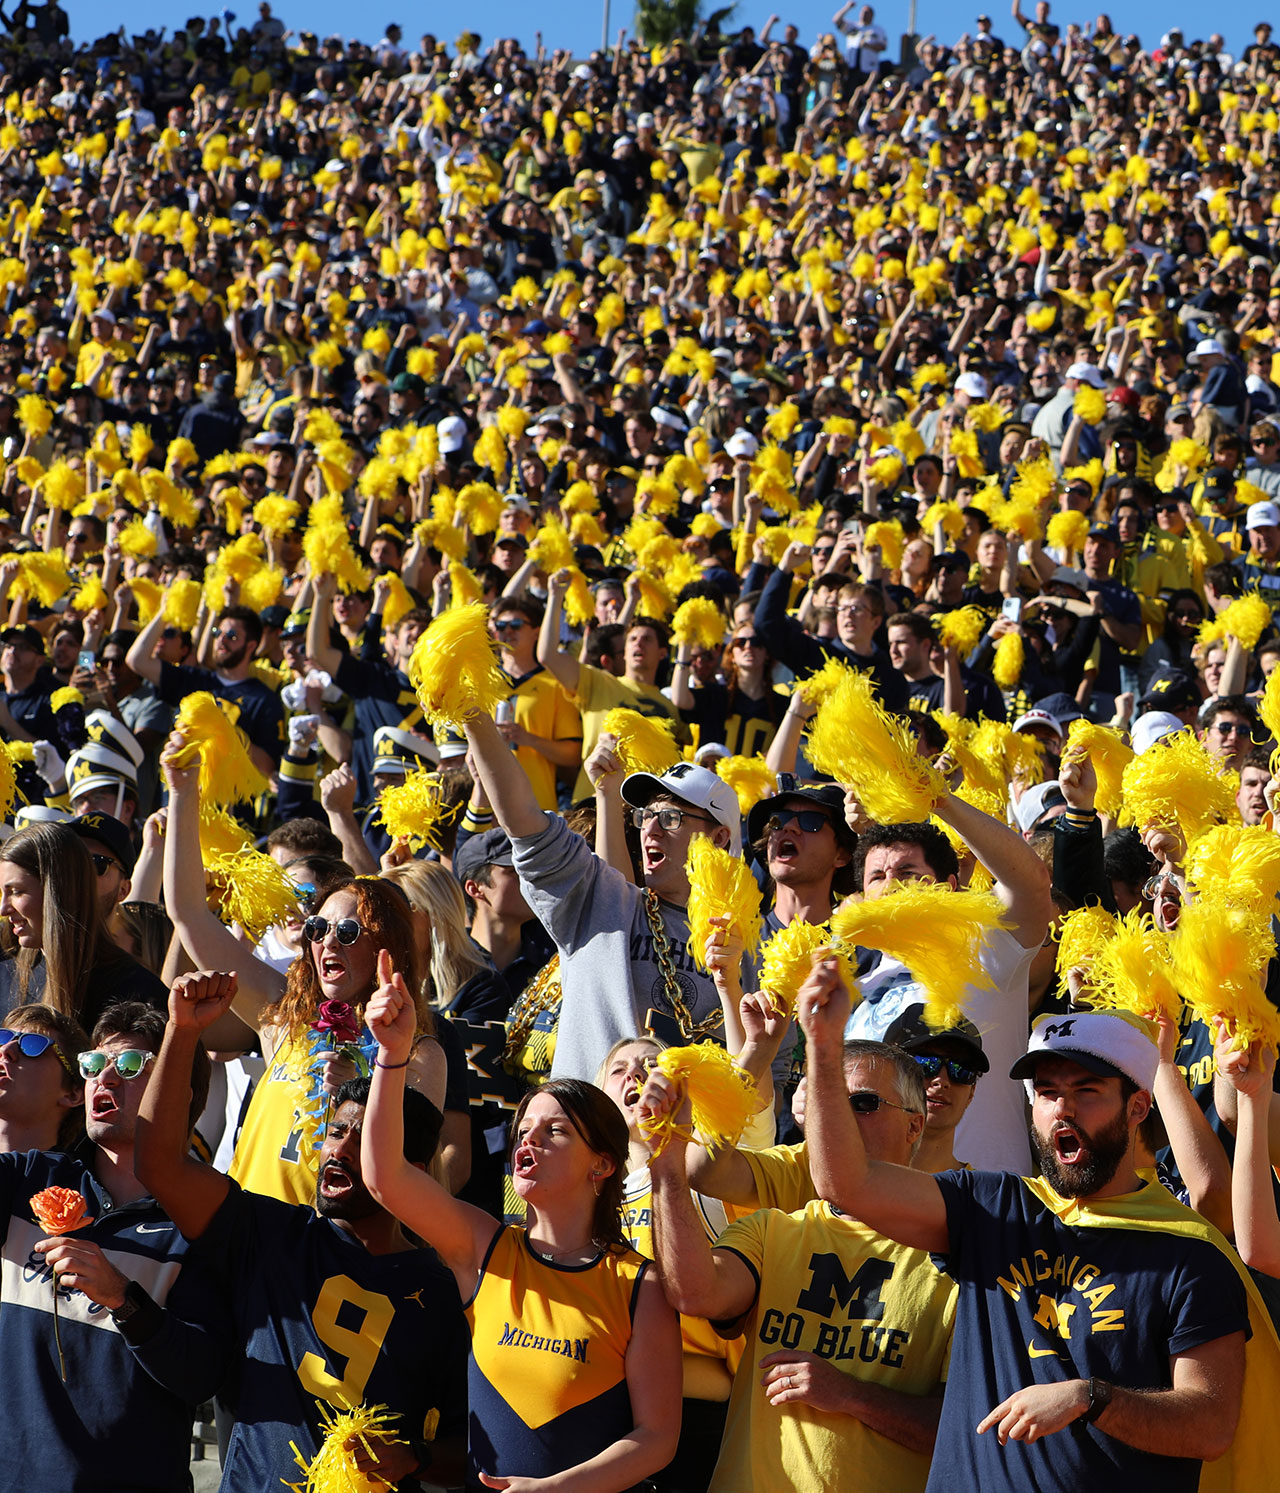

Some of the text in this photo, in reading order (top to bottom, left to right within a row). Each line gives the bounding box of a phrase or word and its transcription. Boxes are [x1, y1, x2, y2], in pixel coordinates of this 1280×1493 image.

[378, 739, 394, 755] M
[724, 714, 777, 759] 10
[81, 815, 104, 829] M
[1043, 1019, 1077, 1042] M
[797, 1252, 896, 1321] M
[996, 1249, 1126, 1332] MICHIGAN
[759, 1308, 910, 1369] GO BLUE
[1033, 1293, 1078, 1340] M
[296, 1274, 397, 1411] 9
[498, 1322, 590, 1364] MICHIGAN
